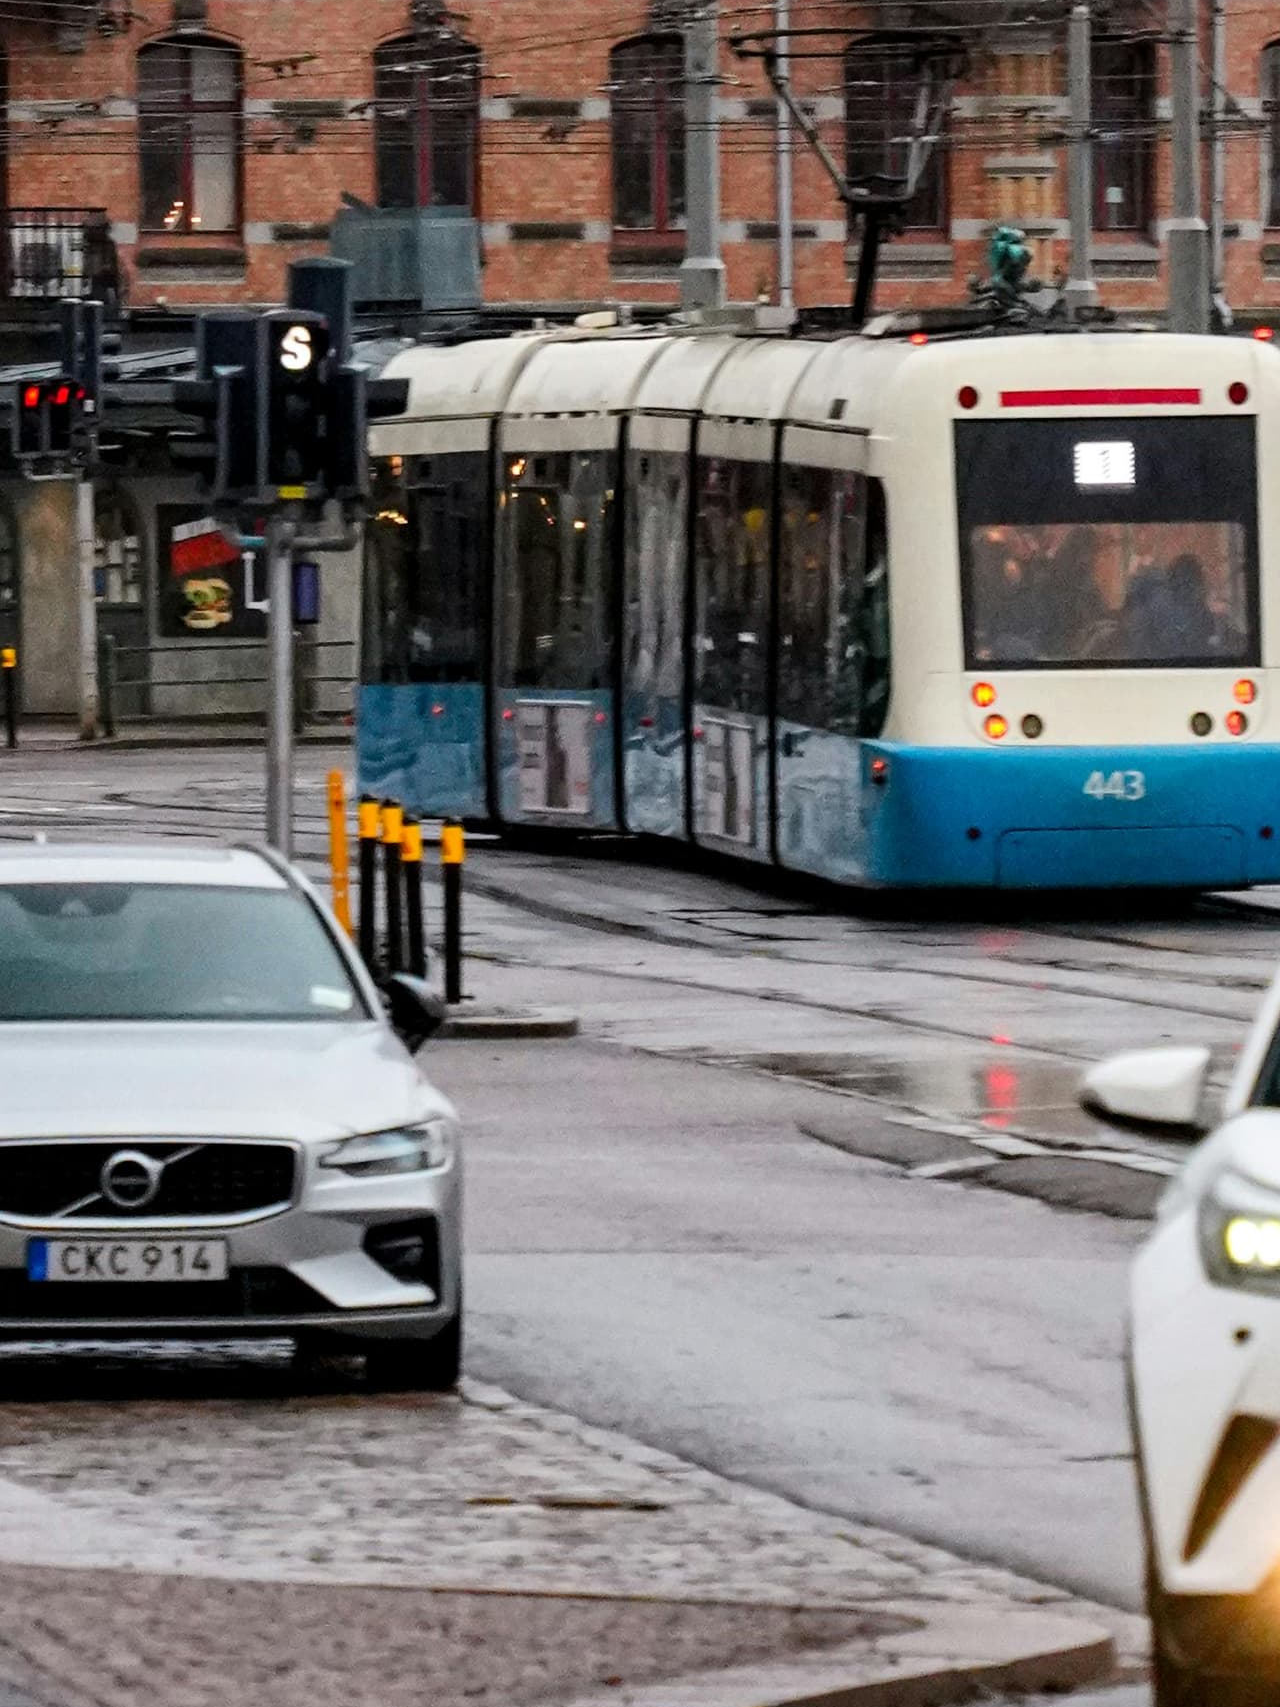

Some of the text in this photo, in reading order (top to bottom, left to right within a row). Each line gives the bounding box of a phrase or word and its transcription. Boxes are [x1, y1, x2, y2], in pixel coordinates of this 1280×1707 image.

[280, 325, 312, 371] S
[1082, 770, 1146, 801] 443
[60, 1245, 212, 1276] CKC 914
